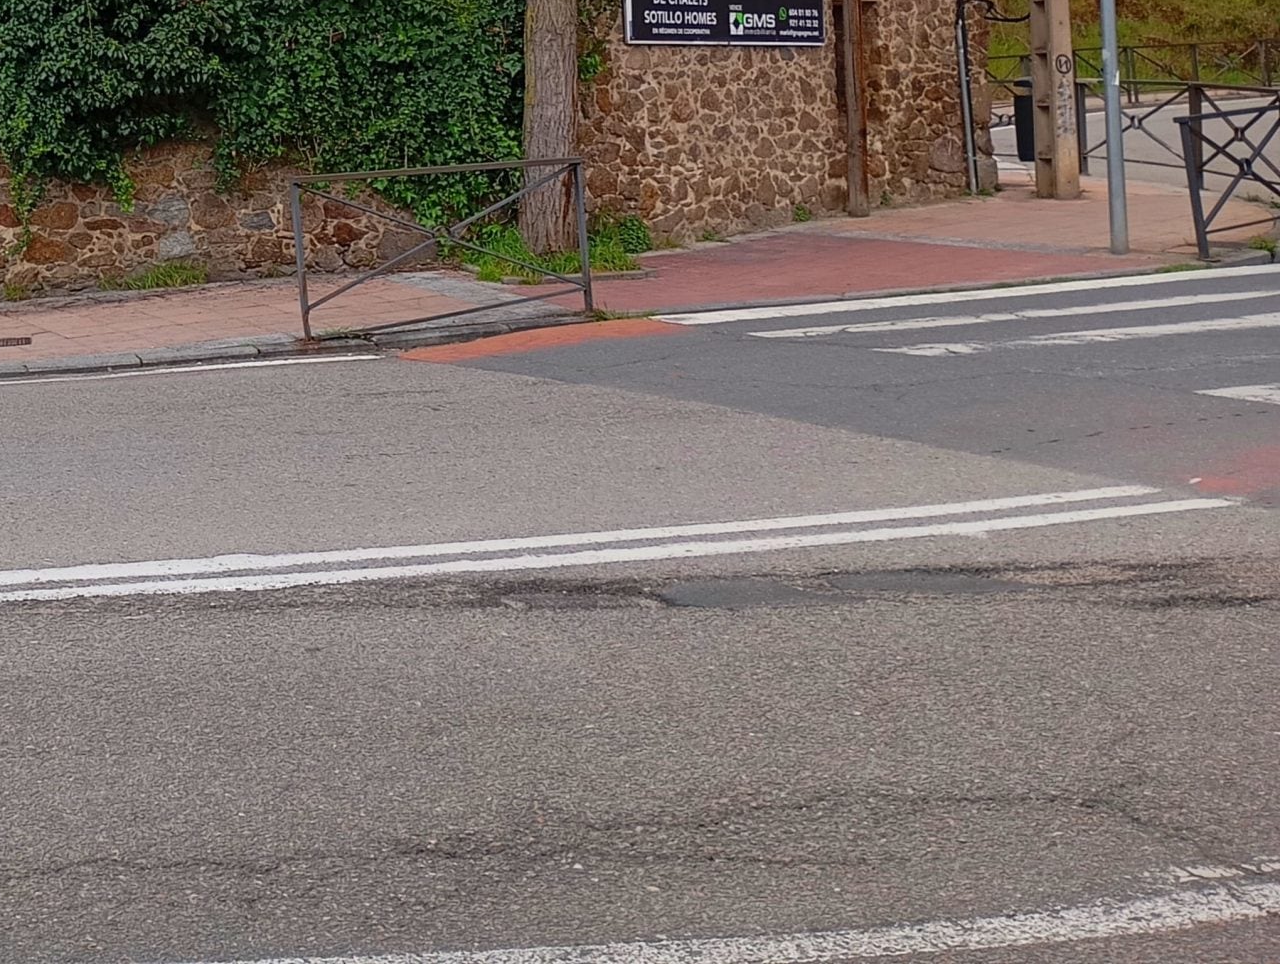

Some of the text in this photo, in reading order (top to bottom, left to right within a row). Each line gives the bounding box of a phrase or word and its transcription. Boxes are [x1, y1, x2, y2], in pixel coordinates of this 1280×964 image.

[643, 10, 718, 25] SOTILLO HOMES
[743, 13, 776, 28] GMS
